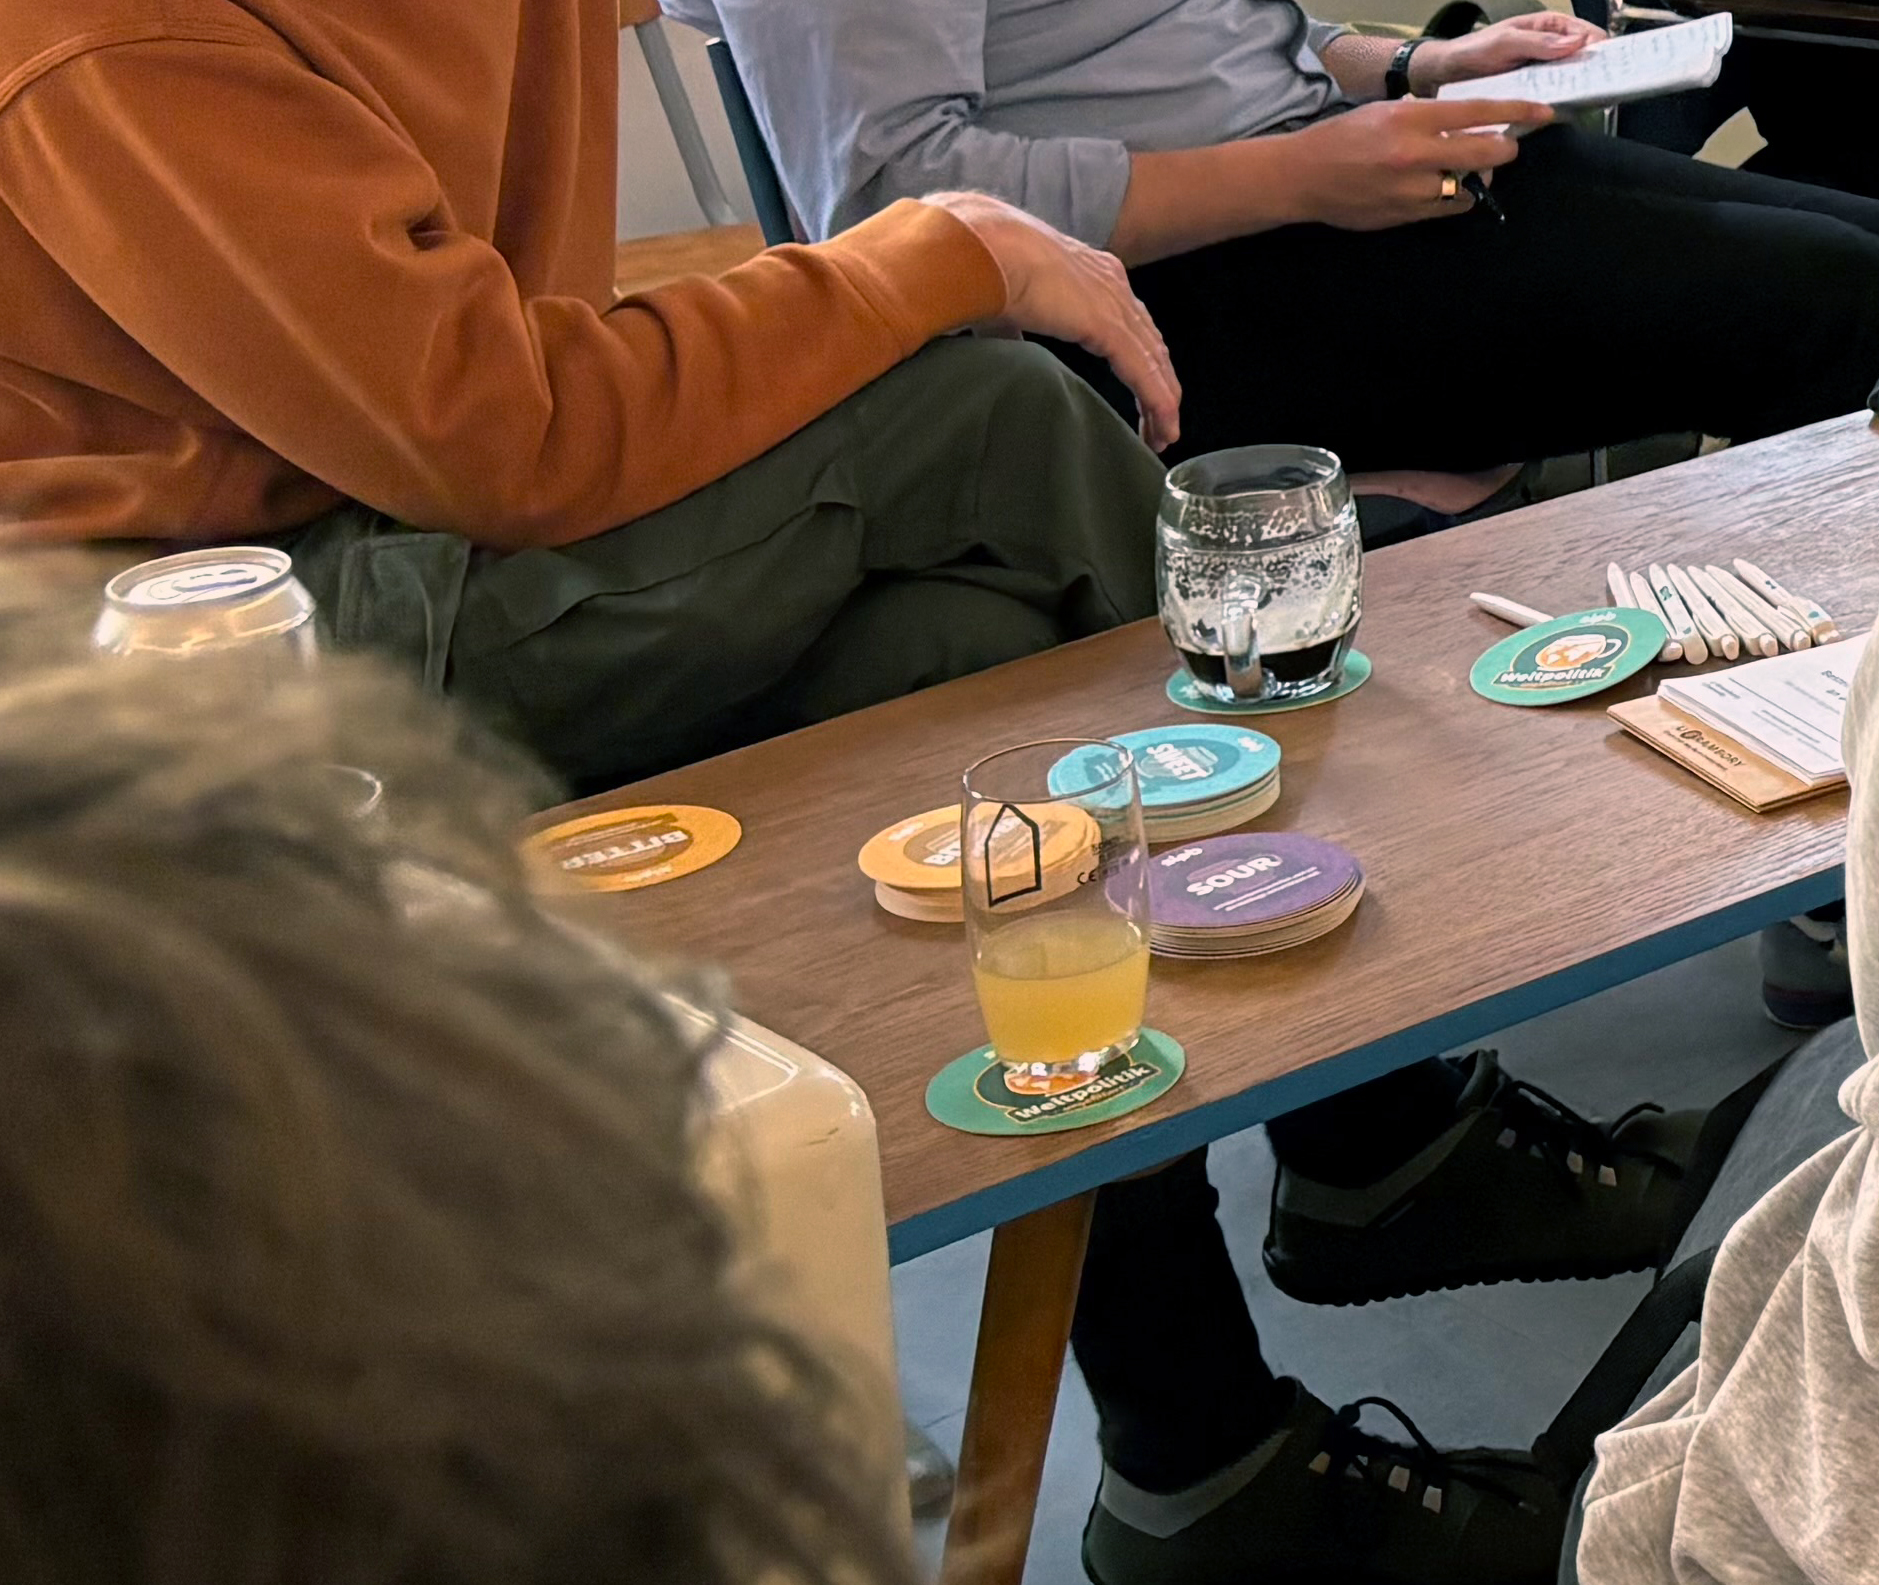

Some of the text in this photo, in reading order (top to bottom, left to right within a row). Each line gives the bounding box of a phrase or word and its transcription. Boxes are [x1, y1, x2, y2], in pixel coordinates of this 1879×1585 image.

[1500, 668, 1605, 683] Weltpolitik
[1146, 743, 1213, 780] SWEET
[562, 830, 689, 870] BITTER
[1186, 857, 1283, 896] SOUR
[1015, 1066, 1150, 1120] Weltpolitik
